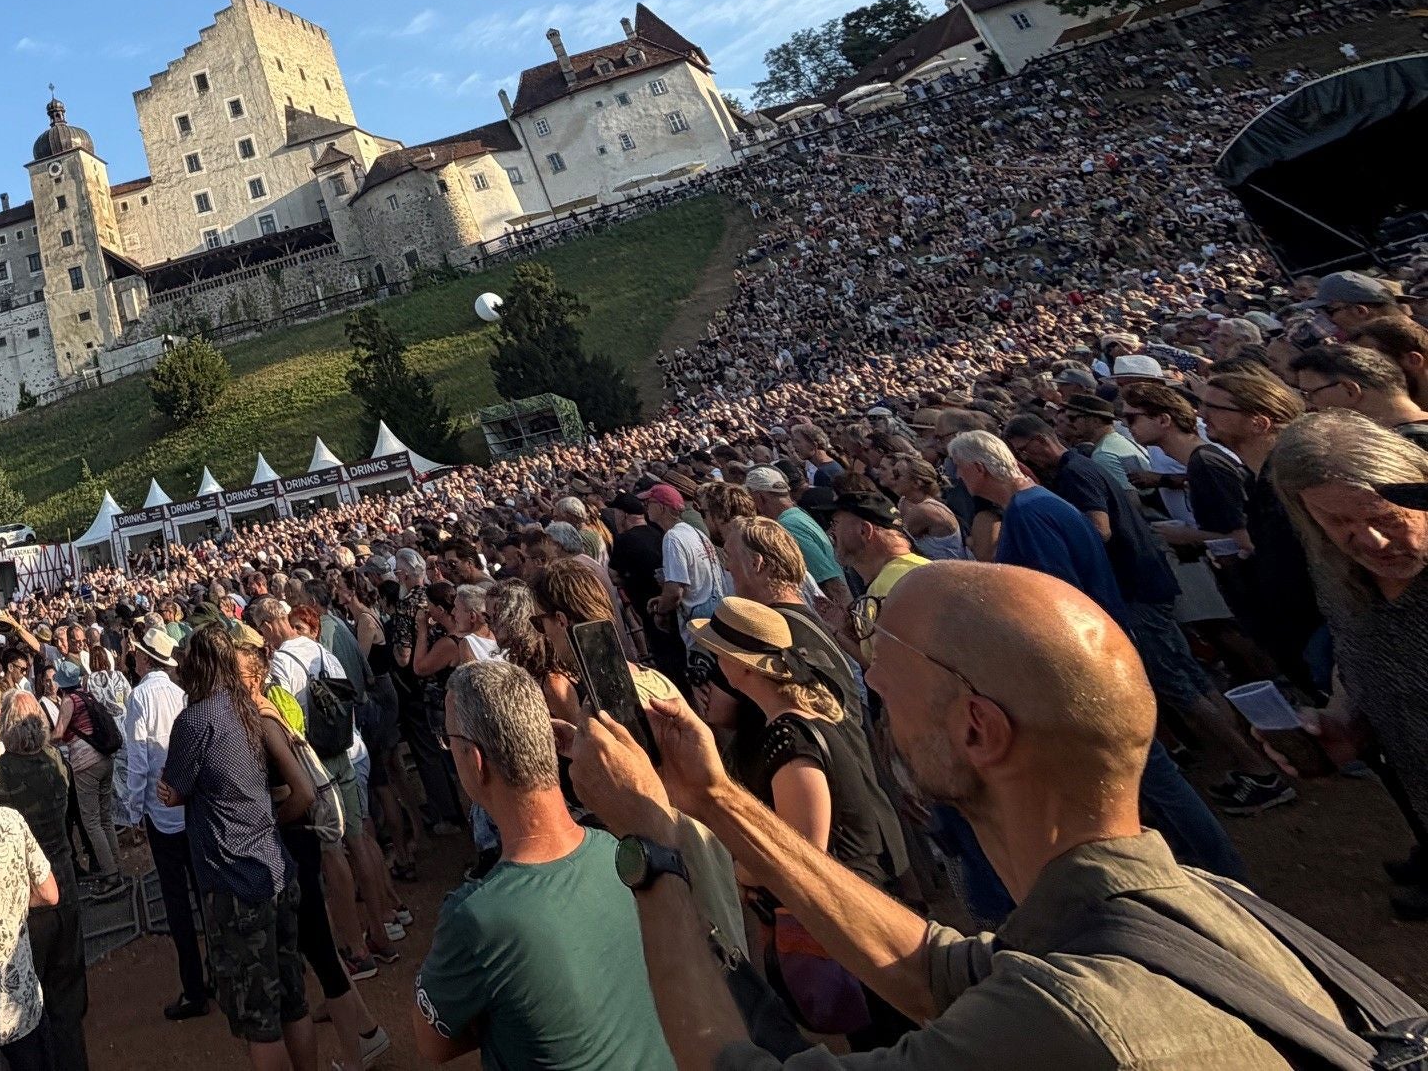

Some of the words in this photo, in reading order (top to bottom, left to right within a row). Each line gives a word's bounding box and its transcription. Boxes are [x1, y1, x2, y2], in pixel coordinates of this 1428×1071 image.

[350, 460, 389, 477] DRINKS
[285, 474, 321, 491] DRINKS
[225, 487, 259, 503] DRINKS
[170, 500, 201, 515] DRINKS
[118, 512, 147, 526] DRINKS
